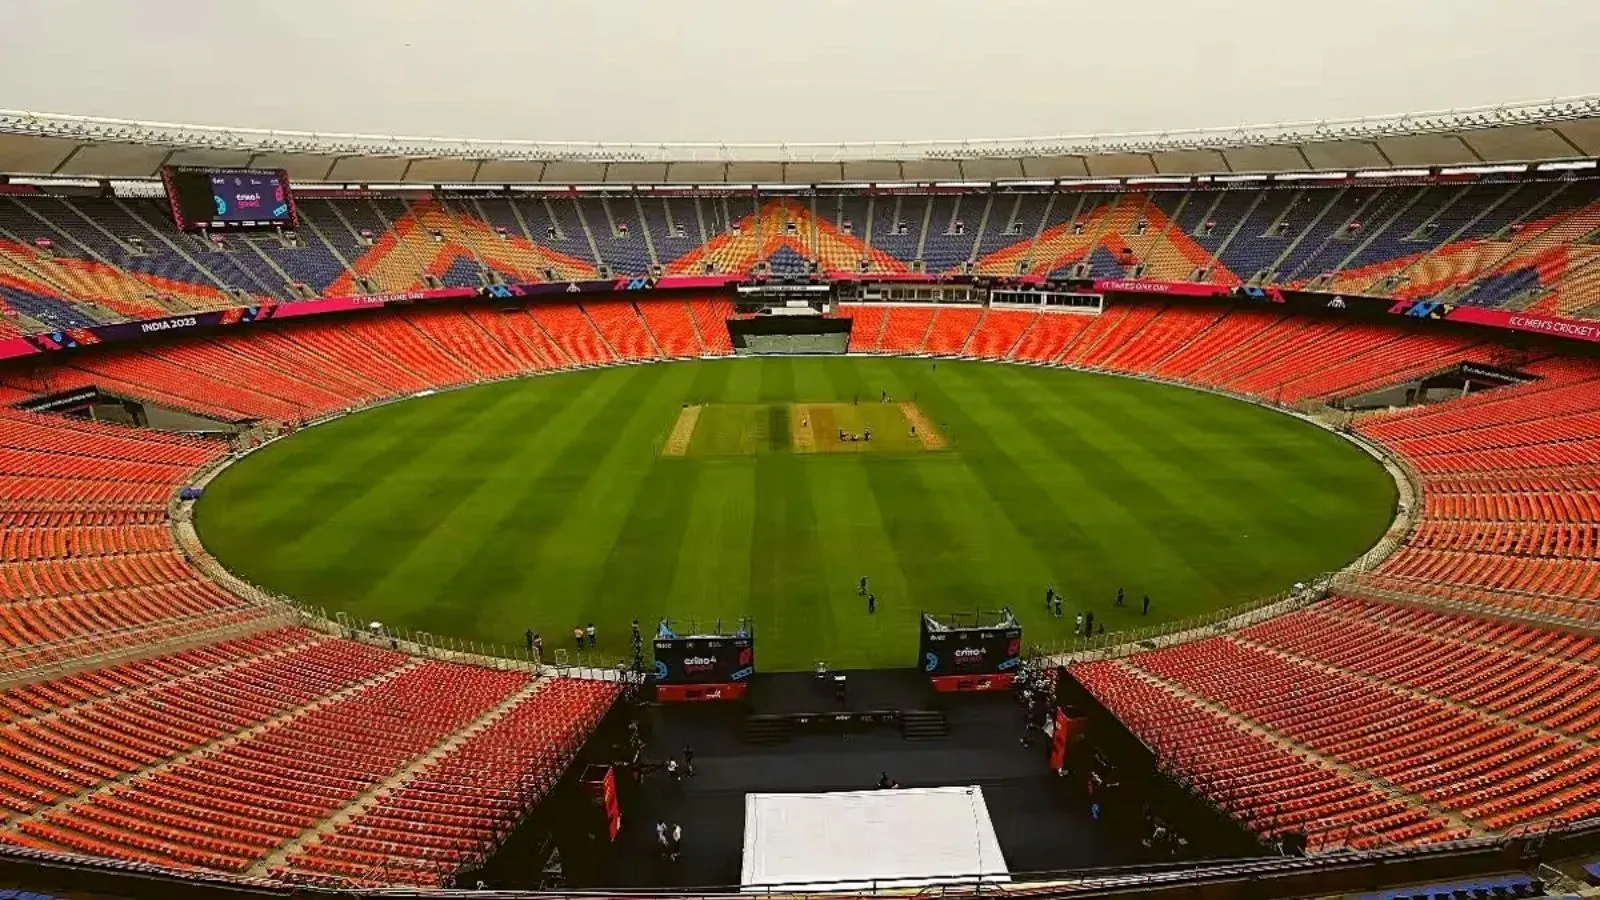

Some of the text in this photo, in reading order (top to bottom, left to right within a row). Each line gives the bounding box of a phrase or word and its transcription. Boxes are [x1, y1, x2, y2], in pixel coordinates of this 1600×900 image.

[1111, 281, 1134, 290] TAKES
[1135, 282, 1152, 290] ONE
[362, 295, 388, 304] TAKES
[141, 317, 197, 333] INDIA 2023
[1508, 316, 1524, 326] ICC
[1524, 318, 1553, 330] MEN'S
[1553, 321, 1595, 337] CRICKET
